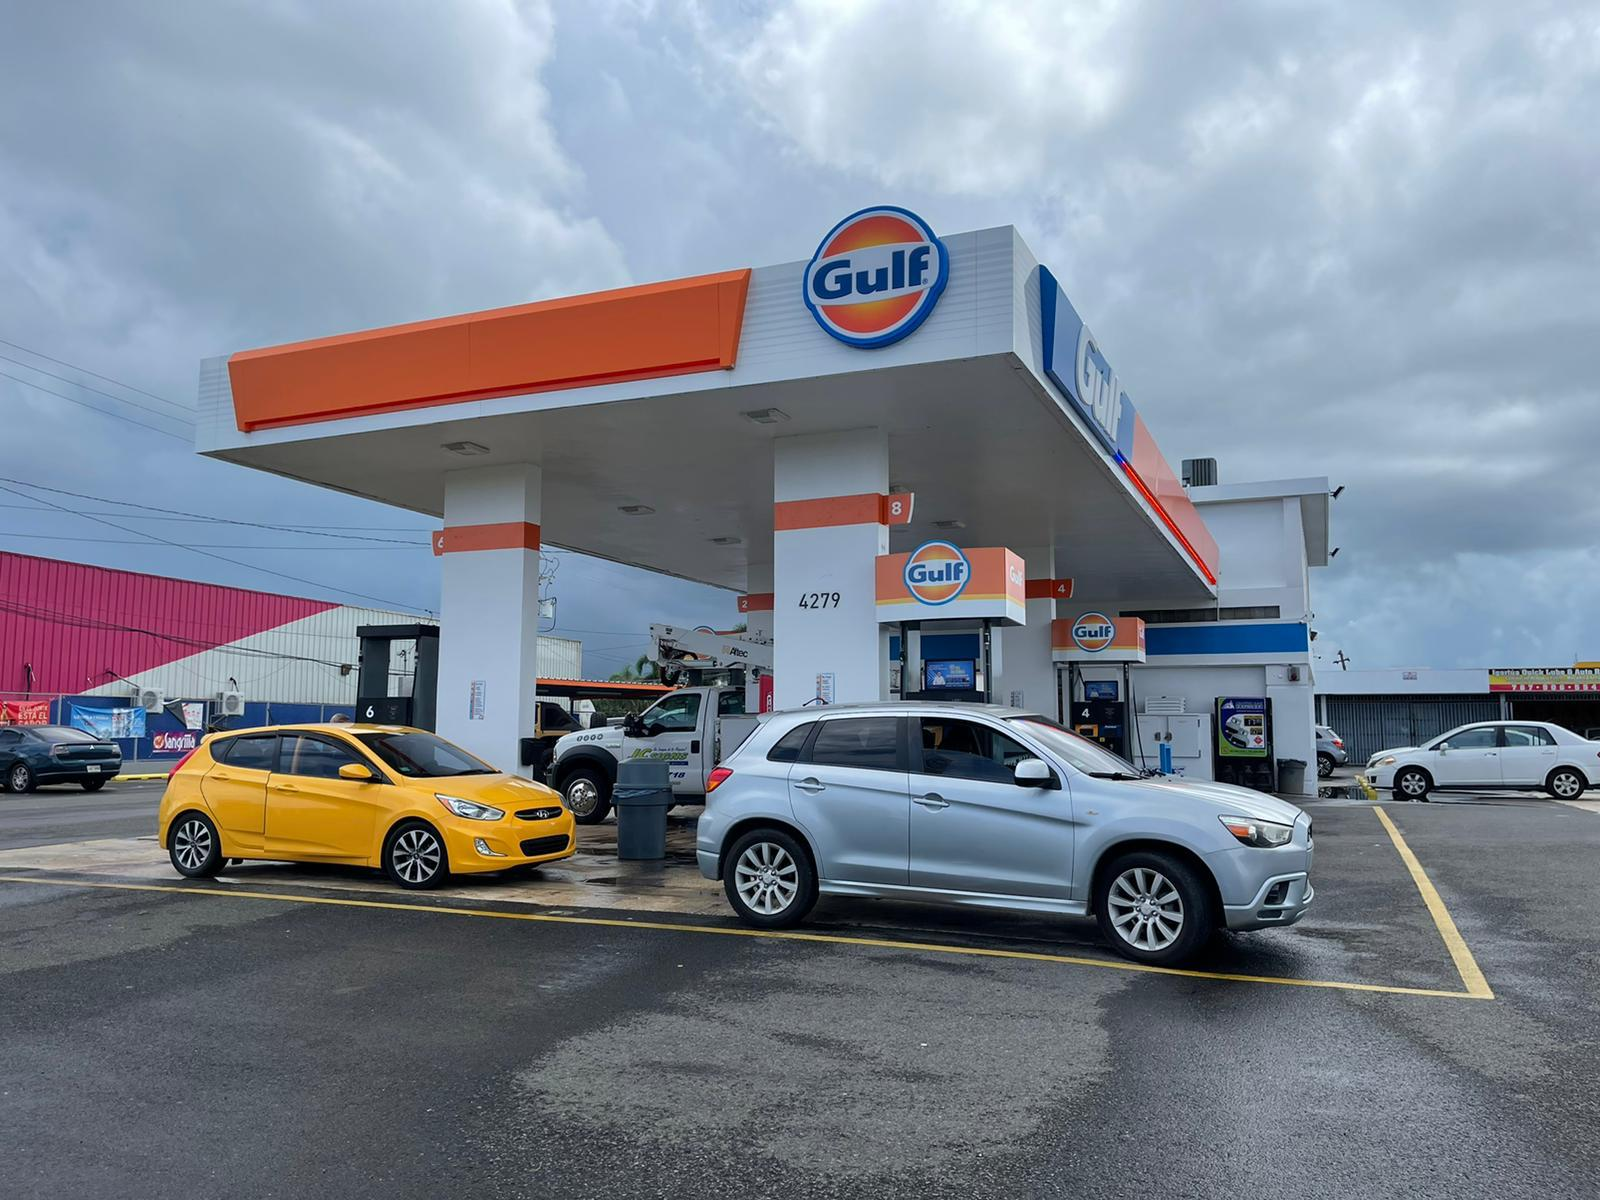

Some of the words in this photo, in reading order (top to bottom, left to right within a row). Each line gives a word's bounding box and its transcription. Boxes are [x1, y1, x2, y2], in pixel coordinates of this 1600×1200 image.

[813, 246, 931, 299] Gulf
[1075, 323, 1126, 443] Gulf
[891, 501, 902, 515] 8
[908, 562, 965, 583] Gulf
[1057, 584, 1066, 593] 4
[742, 600, 748, 609] 2
[798, 592, 841, 610] 4279
[1073, 625, 1112, 638] Gulf
[729, 646, 748, 658] Altec
[365, 705, 375, 718] 6
[1081, 708, 1090, 718] 4
